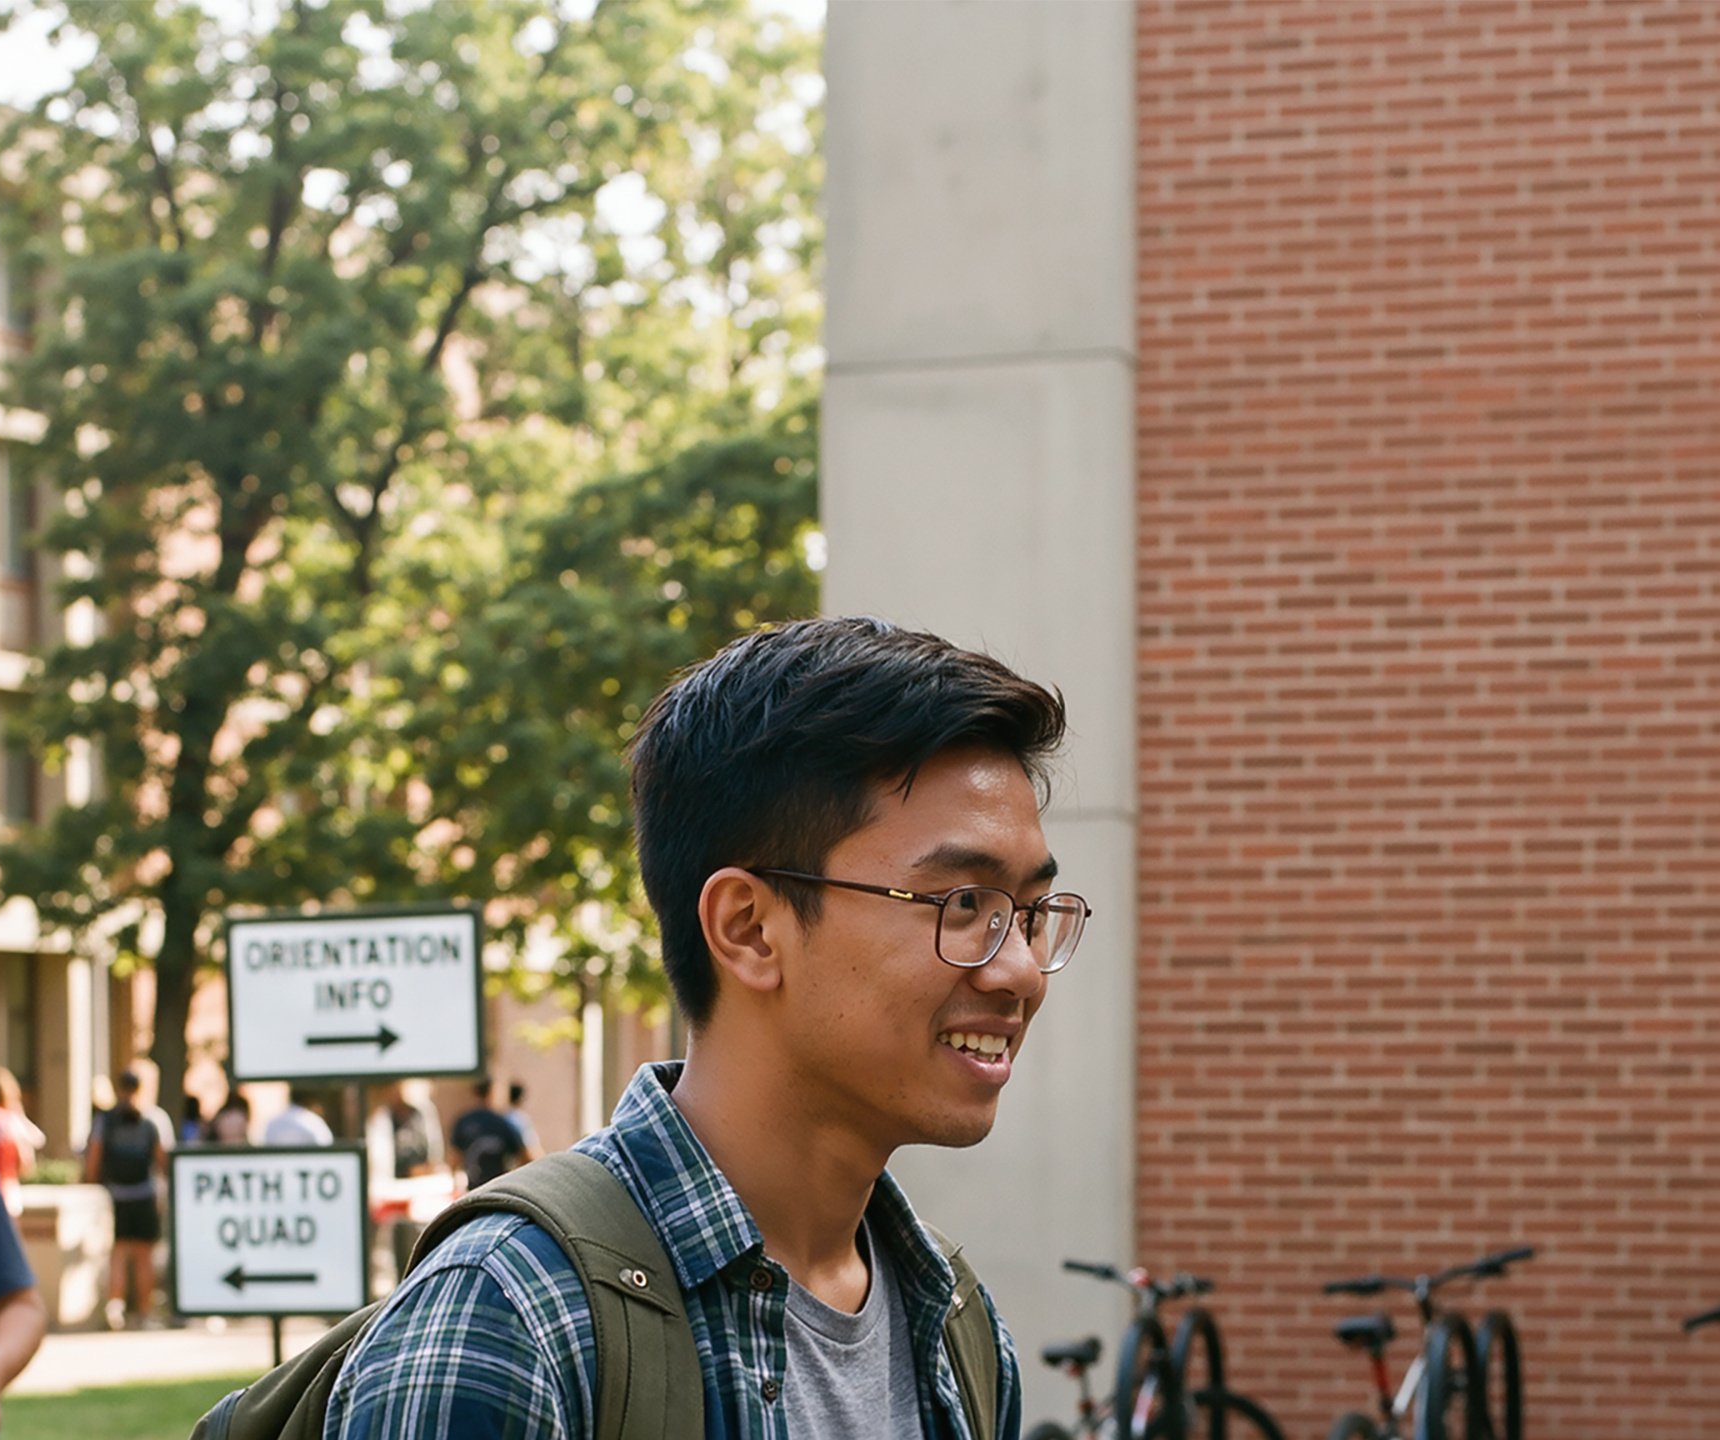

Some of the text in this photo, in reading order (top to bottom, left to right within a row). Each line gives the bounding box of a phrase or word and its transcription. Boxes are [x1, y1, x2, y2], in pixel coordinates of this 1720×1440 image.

[247, 935, 461, 971] ORIENTATION
[317, 978, 392, 1011] INFO
[194, 1170, 341, 1202] PATH TO
[218, 1215, 317, 1251] QUAD
